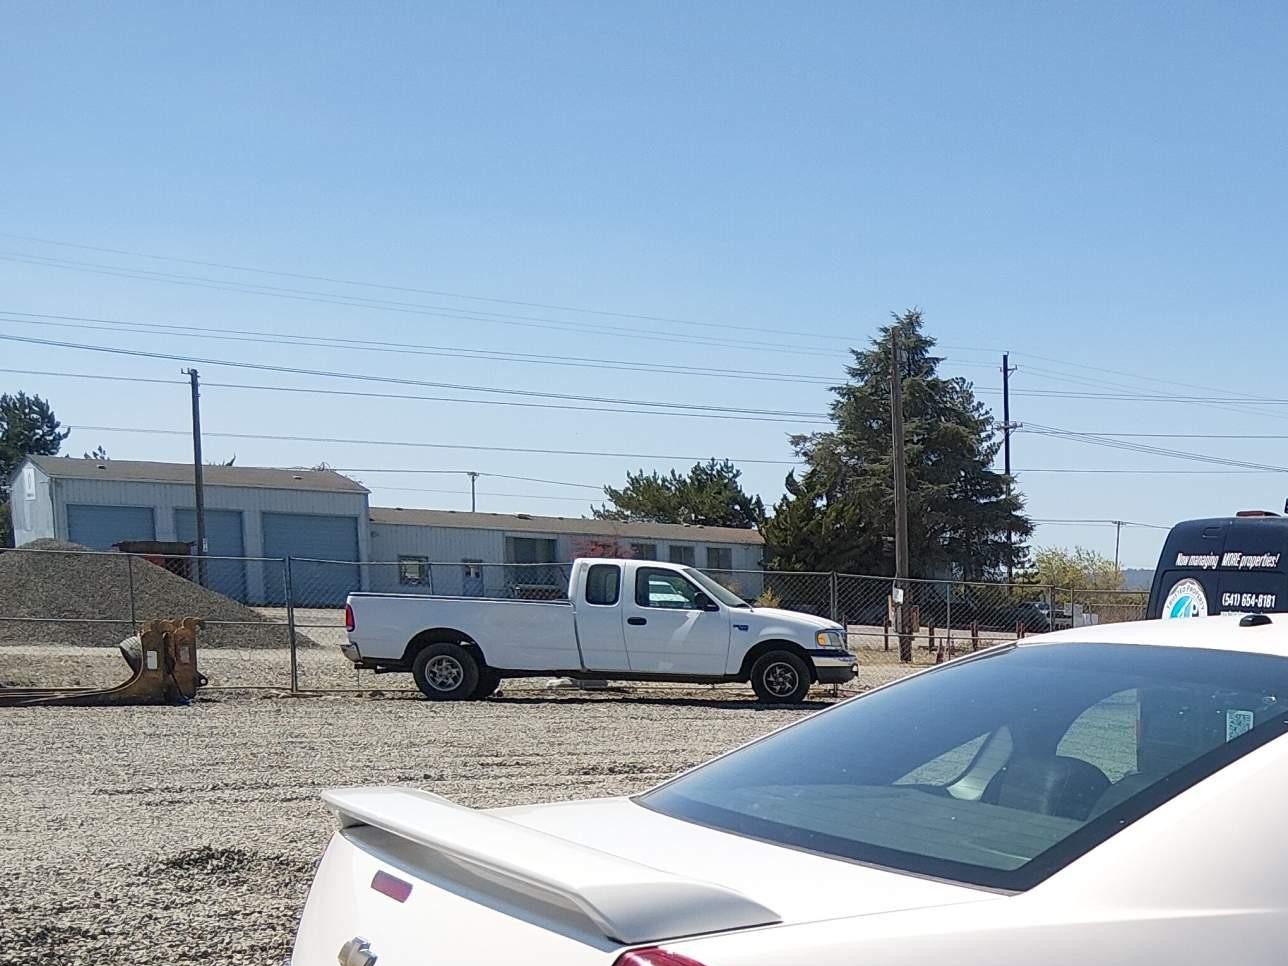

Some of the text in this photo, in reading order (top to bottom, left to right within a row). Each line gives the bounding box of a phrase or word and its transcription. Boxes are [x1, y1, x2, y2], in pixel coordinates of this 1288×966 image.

[1175, 552, 1280, 569] Now managing MORE properties!
[1222, 593, 1276, 608] (541) 654-8181
